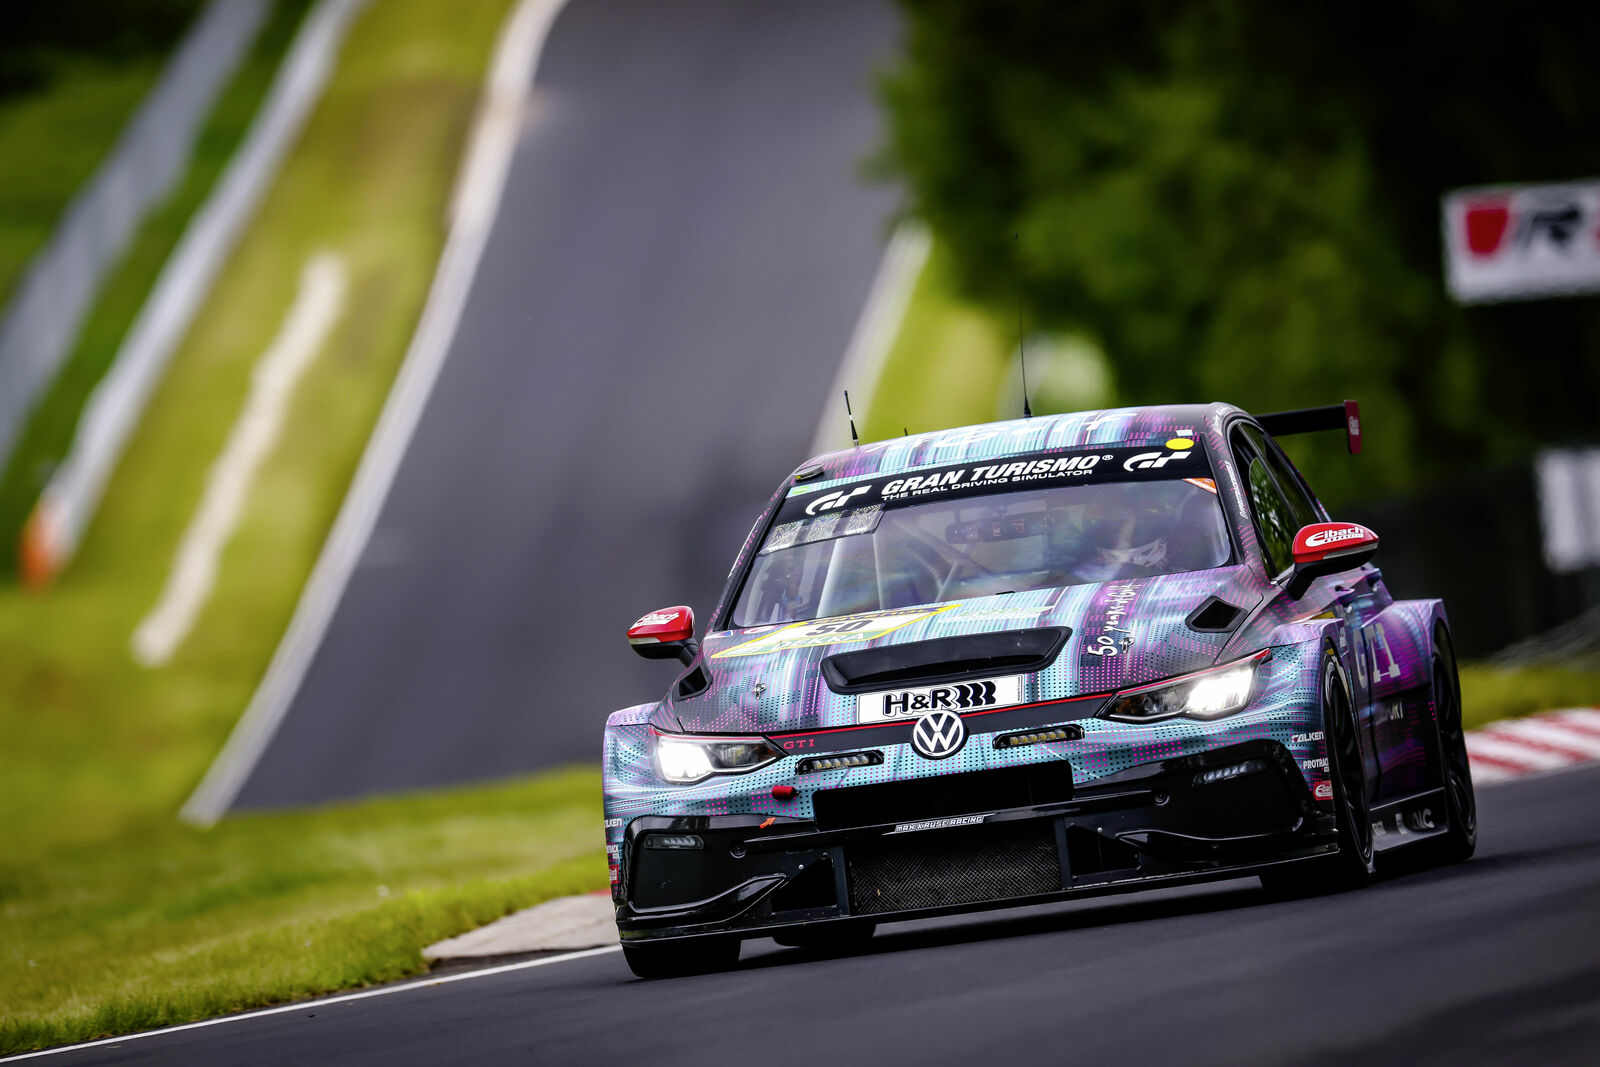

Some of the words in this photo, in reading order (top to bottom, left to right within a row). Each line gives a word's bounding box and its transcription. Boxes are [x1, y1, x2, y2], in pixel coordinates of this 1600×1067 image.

[881, 469, 966, 496] GRAN
[881, 491, 909, 501] THE
[912, 485, 948, 497] REAL
[951, 477, 1009, 490] DRIVING
[1011, 469, 1093, 482] SIMULATOR
[1305, 526, 1364, 547] Eibach
[806, 619, 873, 636] 50
[774, 632, 864, 650] DEKRA
[1087, 635, 1118, 657] 50
[883, 687, 956, 717] H&R
[783, 738, 815, 750] GTI
[1291, 731, 1325, 744] FALKEN
[895, 823, 917, 832] MAX
[949, 815, 985, 827] RACING
